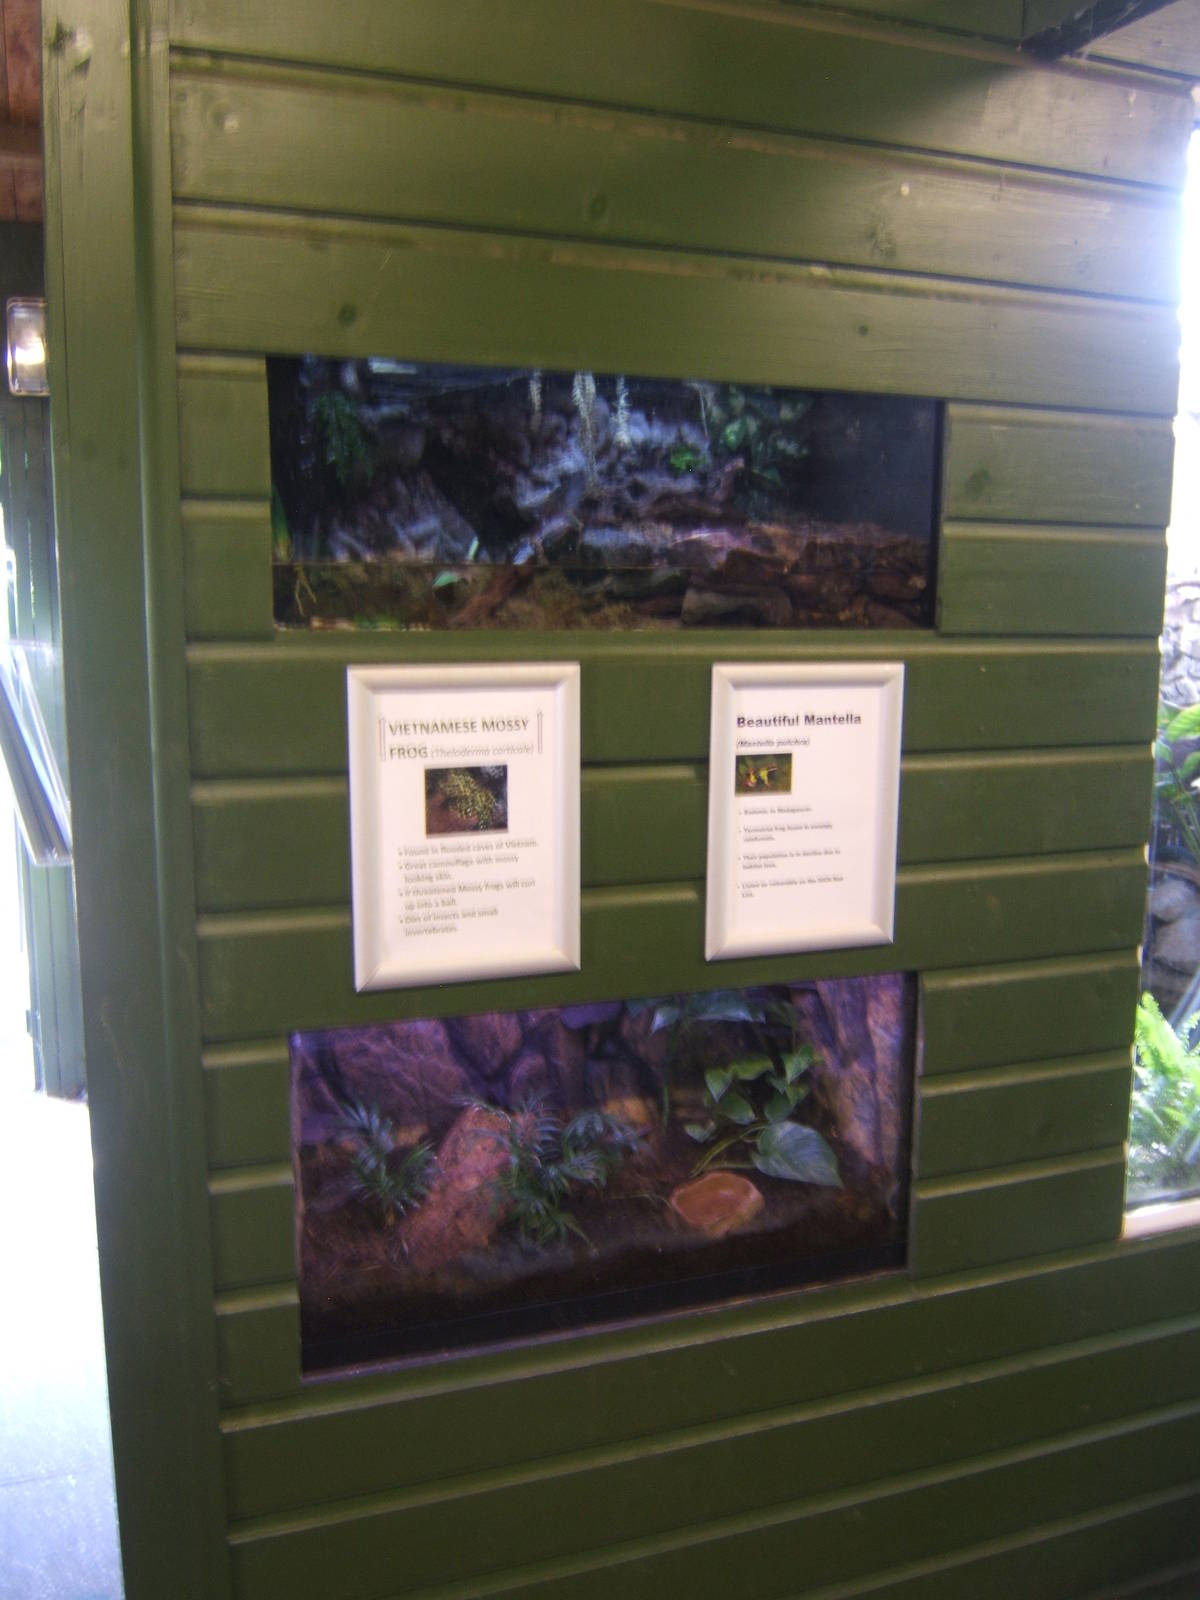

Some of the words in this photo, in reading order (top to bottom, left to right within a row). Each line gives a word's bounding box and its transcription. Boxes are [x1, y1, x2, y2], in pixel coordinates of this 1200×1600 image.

[389, 721, 478, 736] VIETNAMESE
[482, 719, 529, 732] MOSSY
[737, 715, 799, 728] Beautiful
[804, 713, 861, 725] Mantella
[390, 747, 428, 759] FROG
